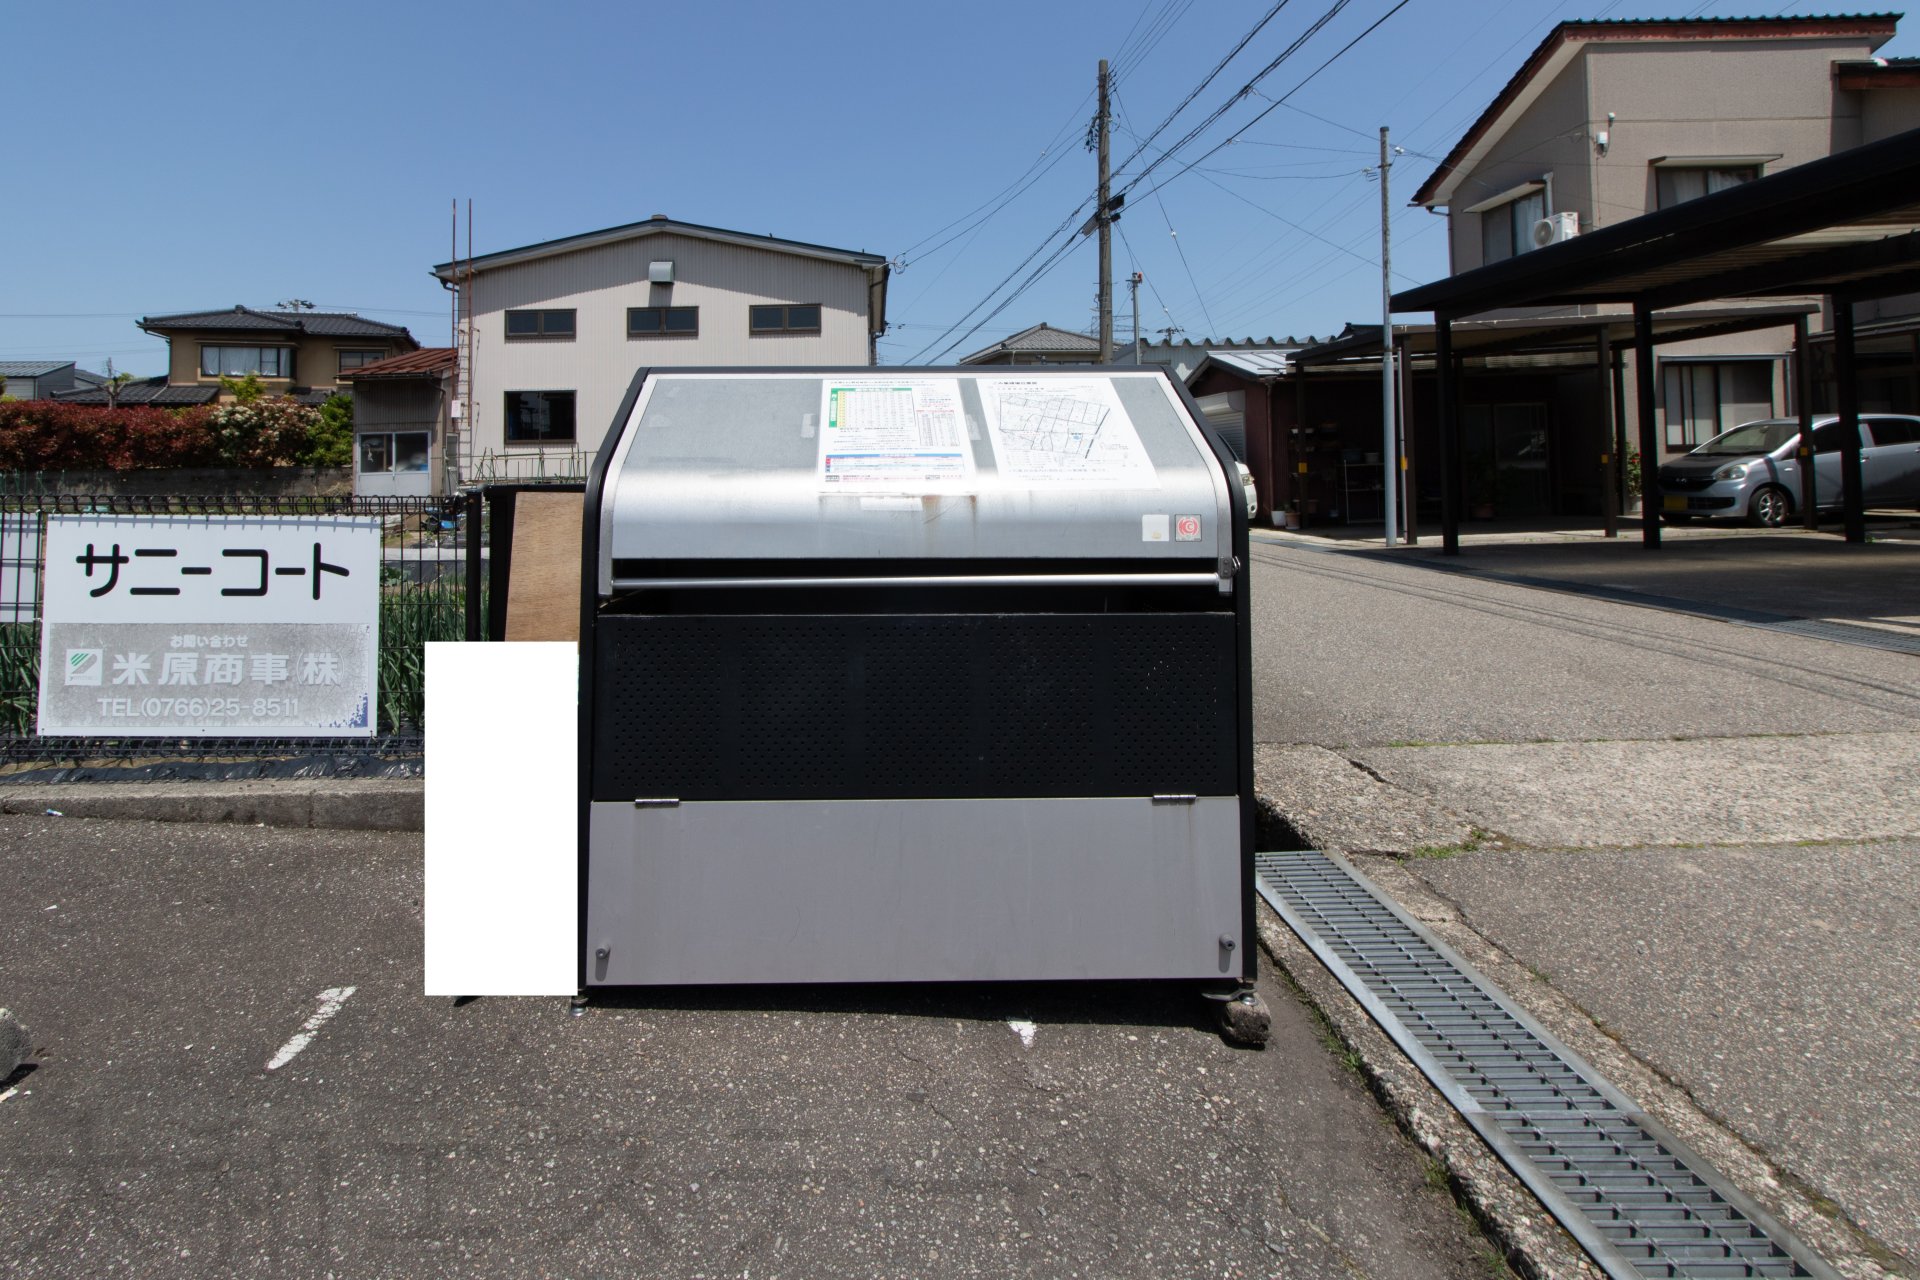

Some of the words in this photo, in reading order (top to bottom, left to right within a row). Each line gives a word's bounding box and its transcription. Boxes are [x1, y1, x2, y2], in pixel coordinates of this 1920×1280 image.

[75, 542, 350, 601] サニーコート
[170, 634, 249, 649] お問い合わせ
